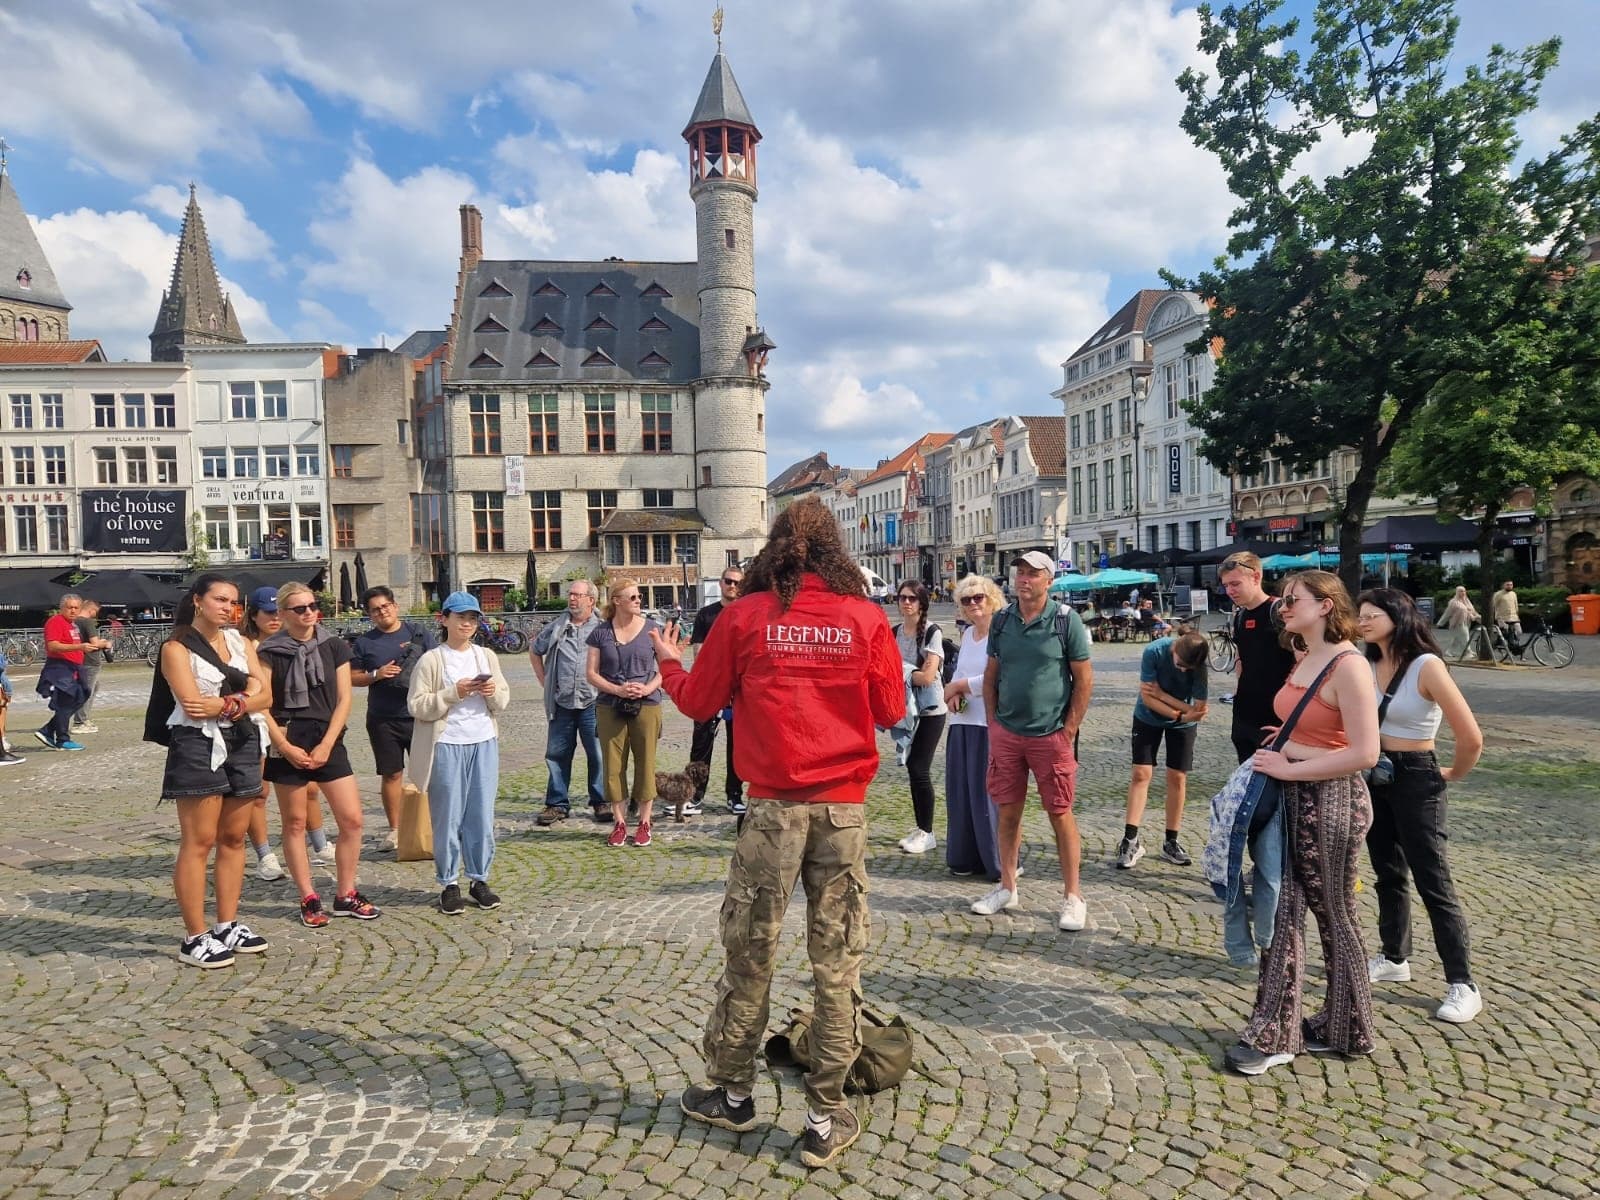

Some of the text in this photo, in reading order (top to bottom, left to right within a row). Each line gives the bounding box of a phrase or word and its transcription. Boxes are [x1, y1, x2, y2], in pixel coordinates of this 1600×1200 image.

[1171, 446, 1179, 486] ODE
[233, 489, 284, 500] ventura
[93, 497, 177, 513] the house
[106, 514, 164, 531] of love
[767, 625, 851, 643] LEGENDS
[767, 644, 795, 652] TOURS
